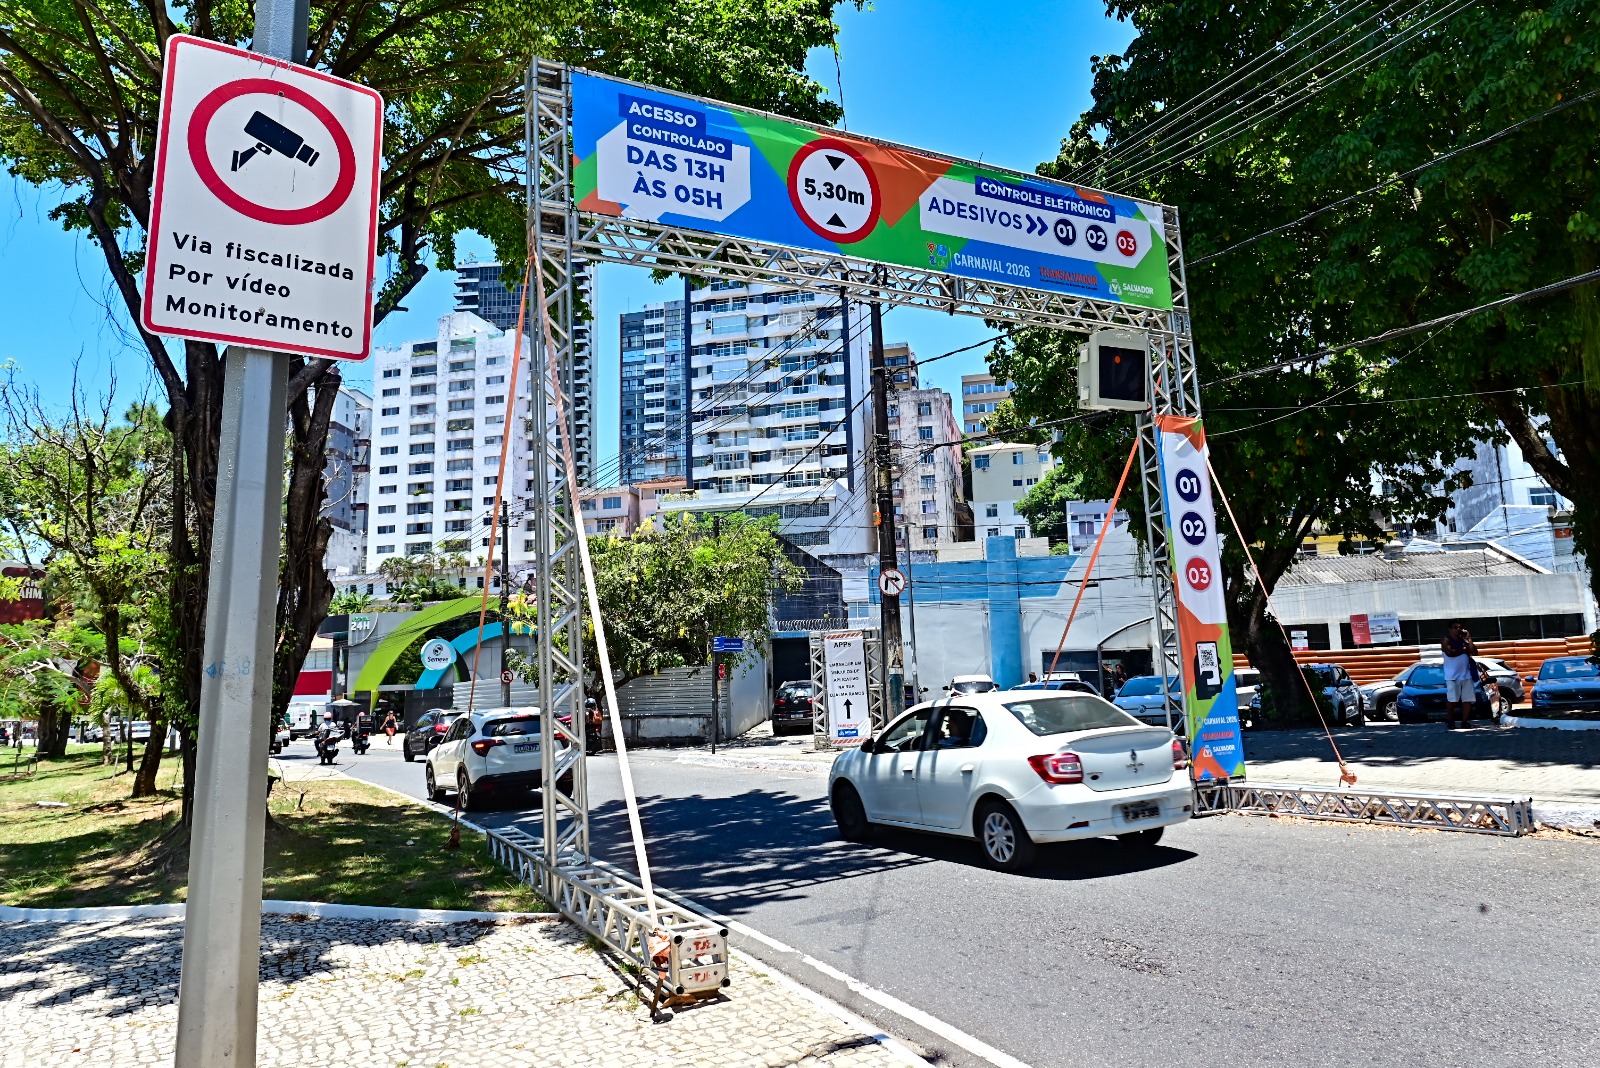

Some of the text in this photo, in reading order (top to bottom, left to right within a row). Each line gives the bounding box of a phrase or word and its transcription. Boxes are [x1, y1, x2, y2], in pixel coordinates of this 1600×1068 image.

[628, 101, 697, 128] ACESSO
[632, 124, 726, 154] CONTROLADO
[627, 144, 725, 183] DAS 13H
[632, 170, 722, 210] ÀS 05H
[804, 177, 865, 206] 5,30m
[980, 181, 1111, 220] CONTROLE ELETRÔNICO
[928, 196, 1136, 251] ADESIVOS 01 02 03
[172, 231, 354, 281] Via fiscalizada
[953, 252, 1031, 278] CARNAVAL 2026
[169, 263, 291, 298] Por vídeo
[1122, 283, 1154, 295] SALVADOR
[165, 294, 353, 339] Monitoramento
[1179, 476, 1198, 494] 01
[1182, 519, 1205, 537] 02
[1188, 567, 1210, 584] 03
[351, 621, 370, 631] 24H
[833, 641, 852, 649] APPs
